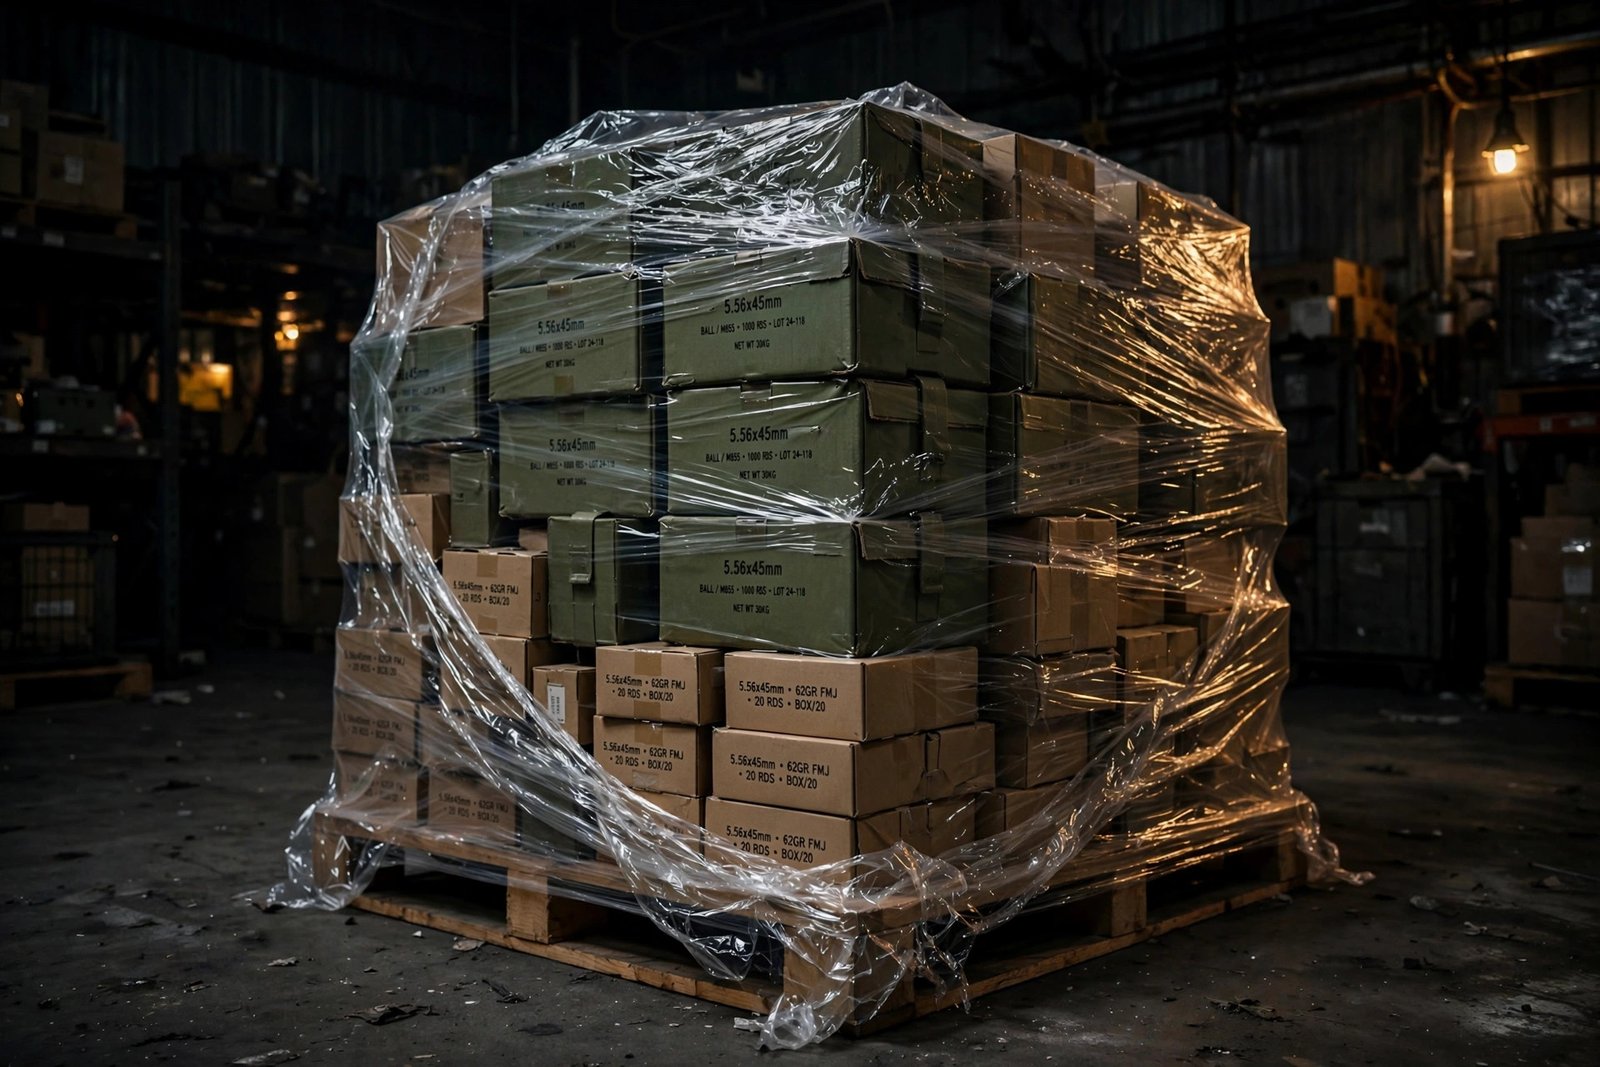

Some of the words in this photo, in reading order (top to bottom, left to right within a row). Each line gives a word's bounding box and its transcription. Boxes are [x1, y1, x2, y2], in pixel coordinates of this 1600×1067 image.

[725, 295, 782, 314] 5.56x45mm
[538, 318, 584, 335] 5.56x45mm
[701, 326, 715, 335] BALL
[742, 322, 755, 331] 1000
[774, 318, 785, 328] LOT
[786, 316, 805, 327] 24-118
[734, 340, 744, 350] NET
[746, 340, 754, 349] WT
[730, 426, 788, 442] 5.56x45mm
[550, 438, 596, 452] 5.56x45mm
[706, 454, 720, 462] BALL
[726, 453, 740, 461] M855
[748, 452, 760, 460] 1000
[780, 450, 791, 460] LOT
[793, 449, 813, 459] 24-118
[740, 471, 750, 479] NET
[752, 471, 760, 479] WT
[762, 471, 777, 479] 30KG
[724, 560, 783, 576] 5.56x45mm
[507, 585, 518, 595] FMJ
[700, 584, 714, 593] BALL
[742, 586, 754, 595] 1000
[773, 587, 784, 596] LOT
[786, 587, 806, 597] 24-118
[733, 604, 743, 612] NET
[746, 605, 754, 613] WT
[755, 605, 770, 614] 30KG
[606, 674, 642, 686] 5.56x45mm
[651, 679, 669, 689] 62GR
[671, 680, 685, 690] FMJ
[739, 681, 784, 694] 5.56x45mm
[796, 686, 817, 697] 62GR
[821, 687, 838, 699] FMJ
[618, 688, 626, 697] 20
[628, 689, 640, 698] RDS
[649, 691, 673, 702] BOX/20
[755, 696, 764, 706] 20
[767, 697, 784, 708] RDS
[795, 699, 826, 712] BOX/20
[604, 742, 640, 755] 5.56x45mm
[650, 747, 667, 758] 62GR
[670, 750, 684, 760] FMJ
[615, 756, 623, 765] 20
[625, 757, 639, 767] RDS
[648, 760, 672, 771] BOX/20
[731, 754, 775, 769] 5.56x45mm
[787, 762, 809, 774] 62GR
[812, 764, 829, 776] FMJ
[746, 770, 756, 781] 20
[759, 772, 775, 784] RDS
[787, 776, 817, 789] BOX/20
[727, 826, 771, 842] 5.56x45mm
[783, 835, 805, 848] 62GR
[809, 839, 826, 851] FMJ
[741, 842, 750, 852] 20
[753, 844, 770, 856] RDS
[782, 849, 813, 863] BOX/20
